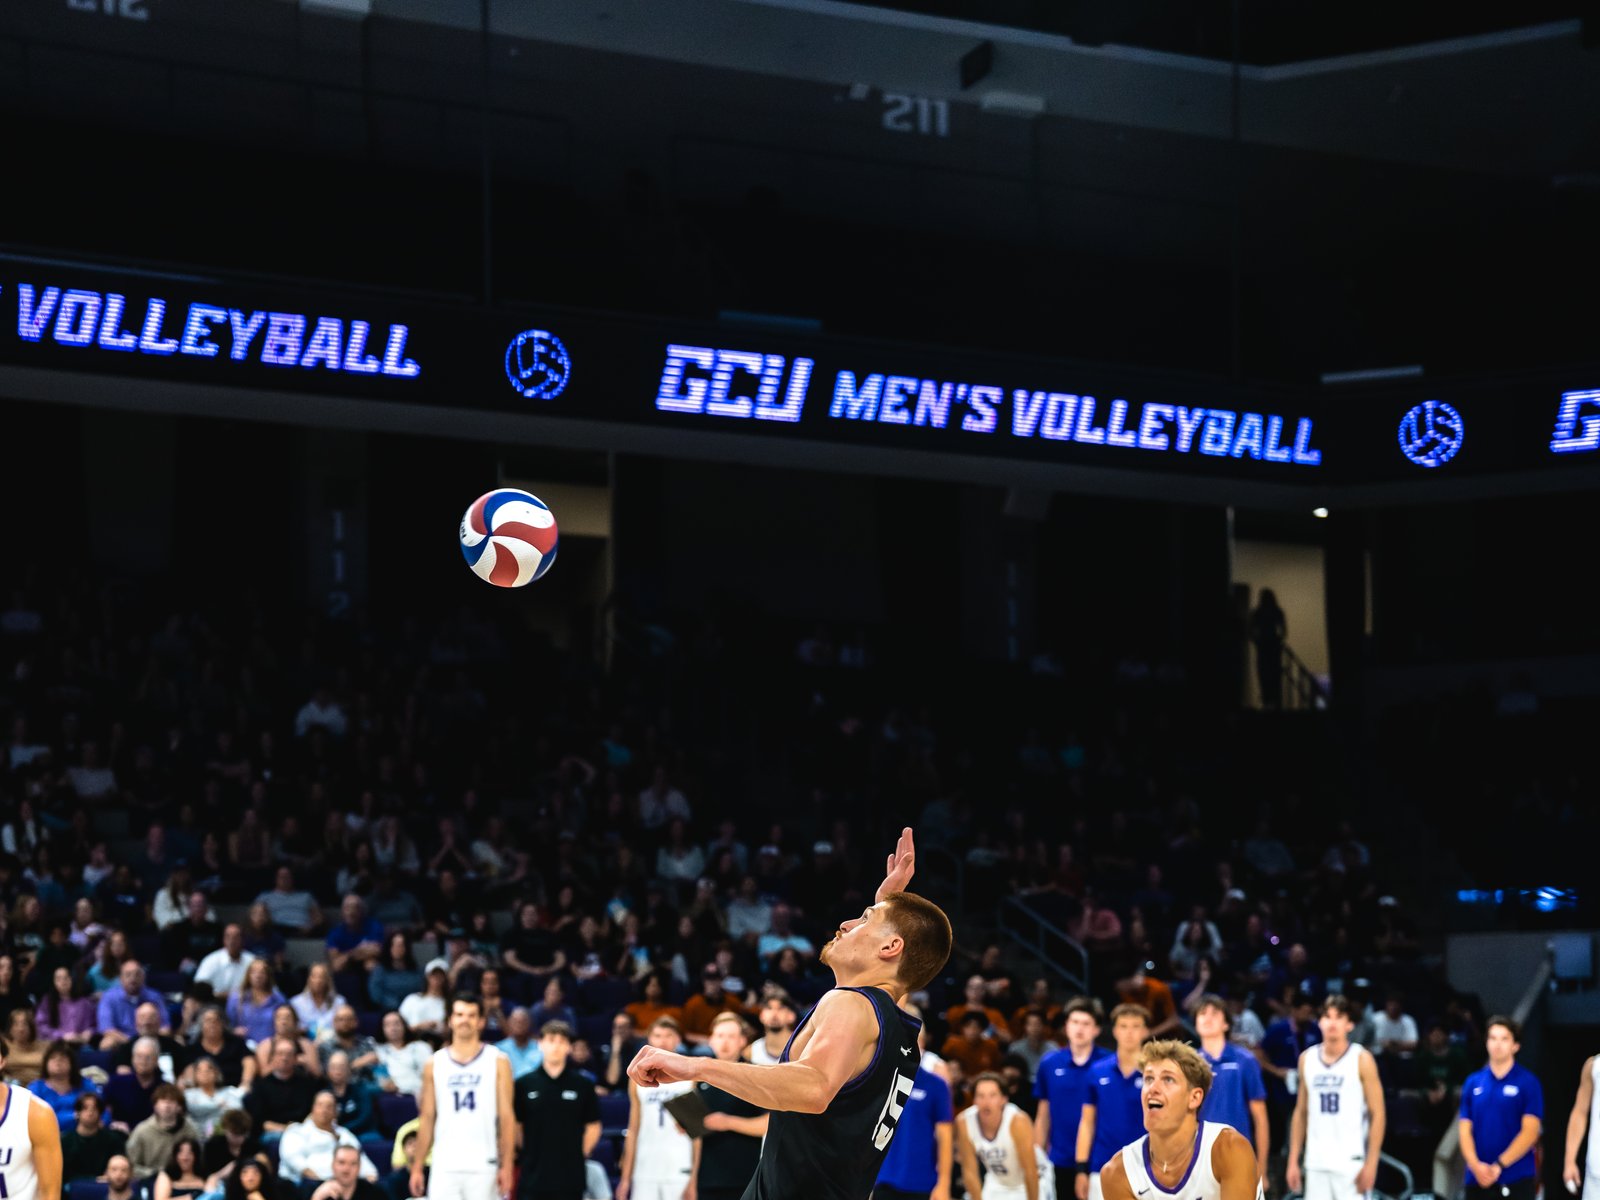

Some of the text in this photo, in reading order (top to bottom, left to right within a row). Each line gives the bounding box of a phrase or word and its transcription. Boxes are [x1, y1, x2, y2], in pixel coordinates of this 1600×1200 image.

[882, 95, 950, 137] 211
[17, 283, 421, 379] VOLLEYBALL
[655, 343, 1322, 466] GCU MEN'S VOLLEYBALL
[453, 1090, 476, 1112] 14
[1319, 1092, 1340, 1114] 18
